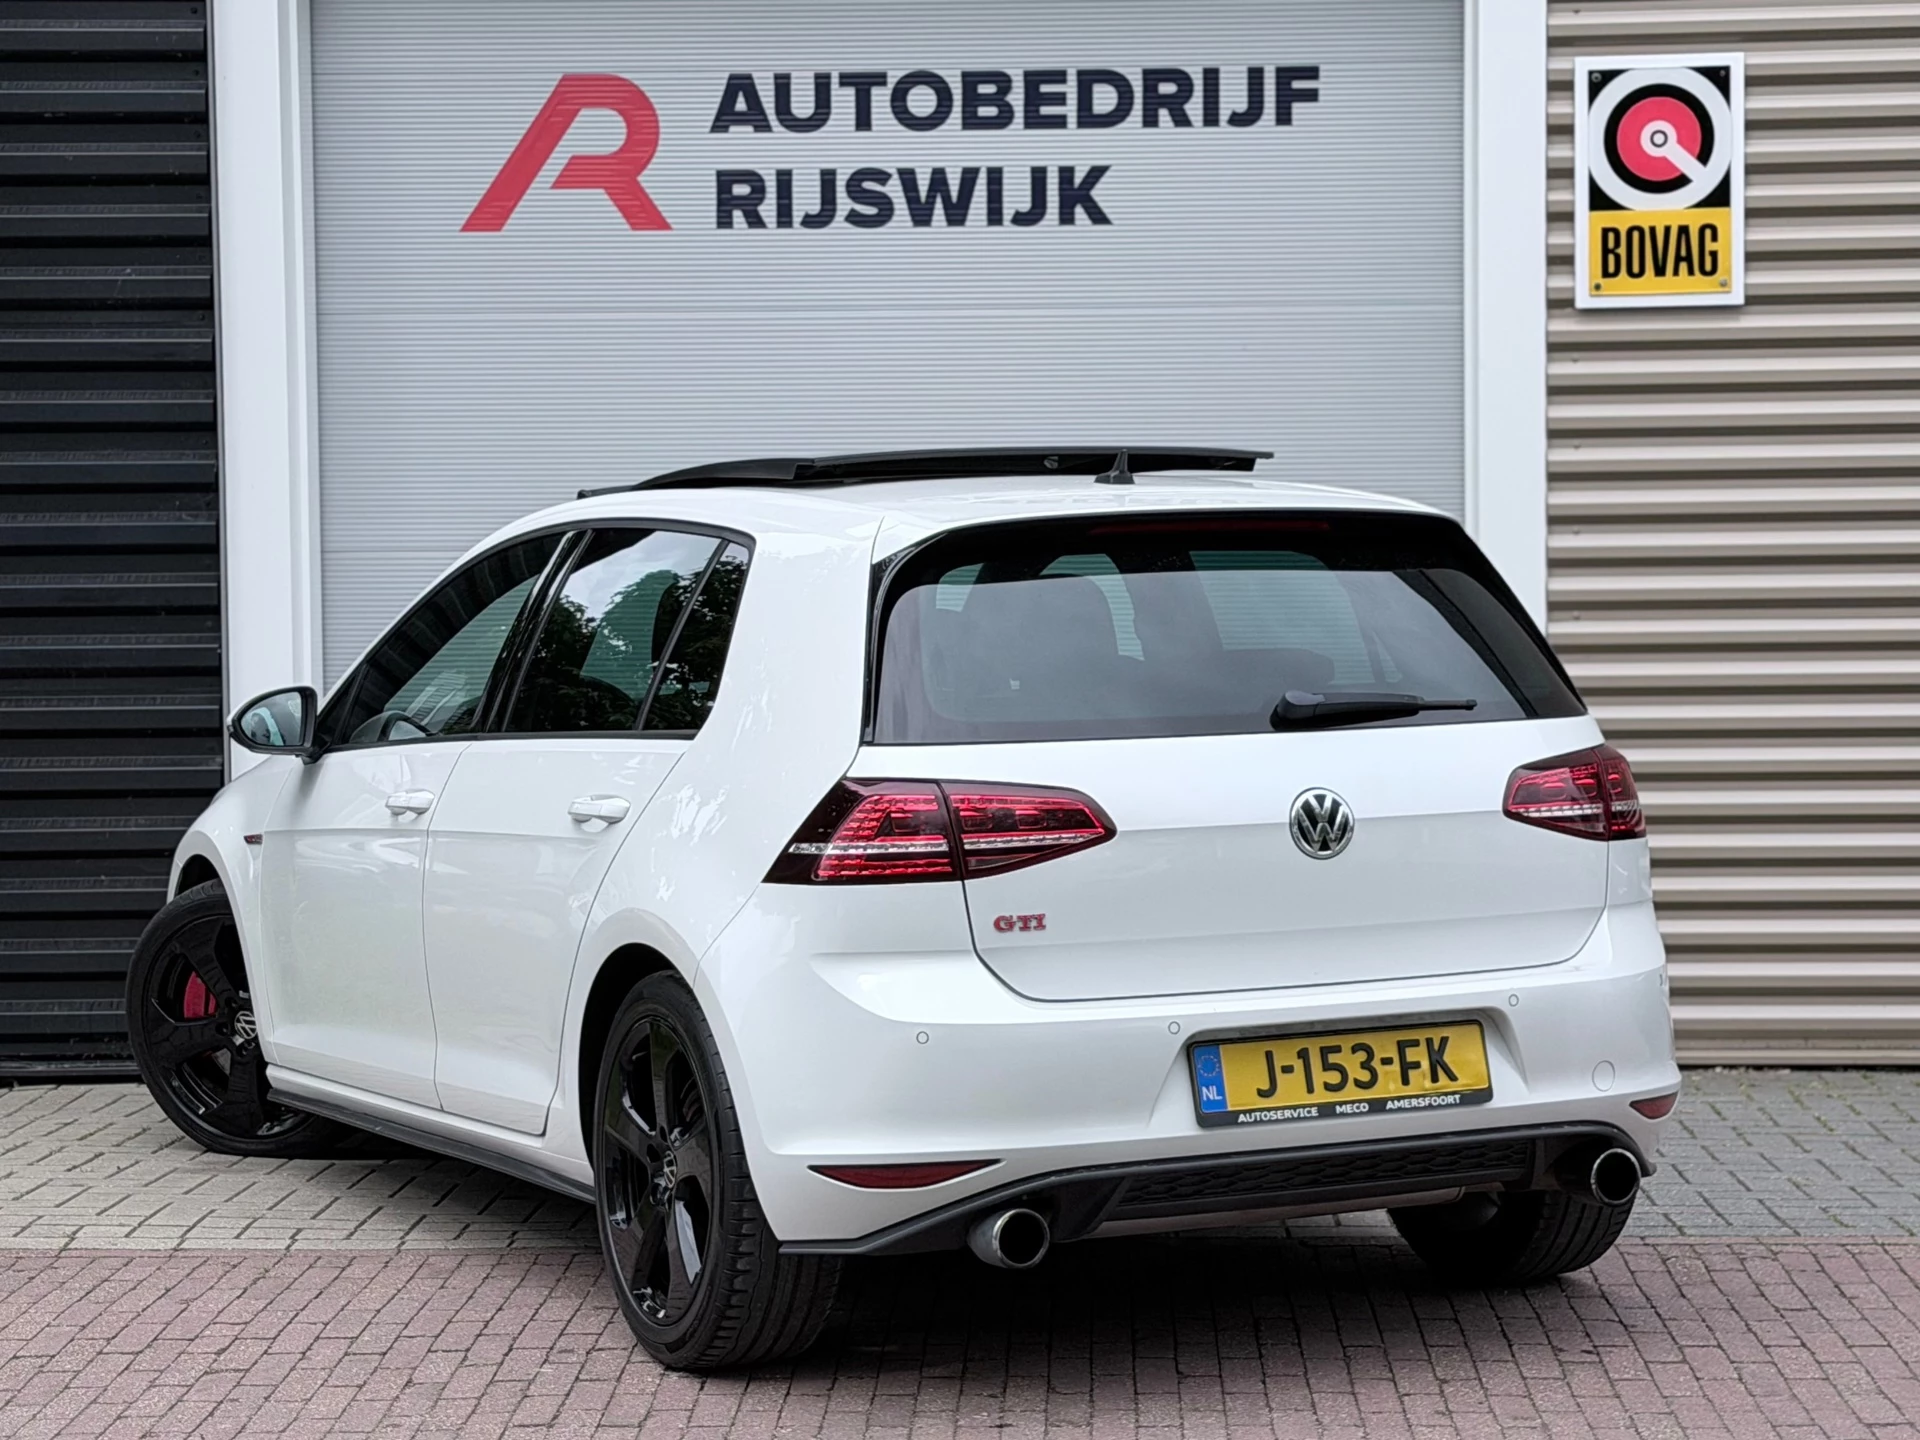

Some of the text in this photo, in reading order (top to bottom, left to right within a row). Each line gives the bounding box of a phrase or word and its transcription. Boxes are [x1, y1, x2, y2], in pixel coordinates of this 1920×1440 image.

[709, 66, 1321, 133] AUTOBEDRIJF
[716, 165, 1112, 229] RIJSWIJK
[1601, 223, 1718, 279] BOVAG
[993, 913, 1046, 933] GTI
[1201, 1085, 1222, 1101] NL
[1256, 1036, 1459, 1098] J-153-FK
[1237, 1094, 1461, 1123] AUTOSERVICE MECO AMERSFOORT
